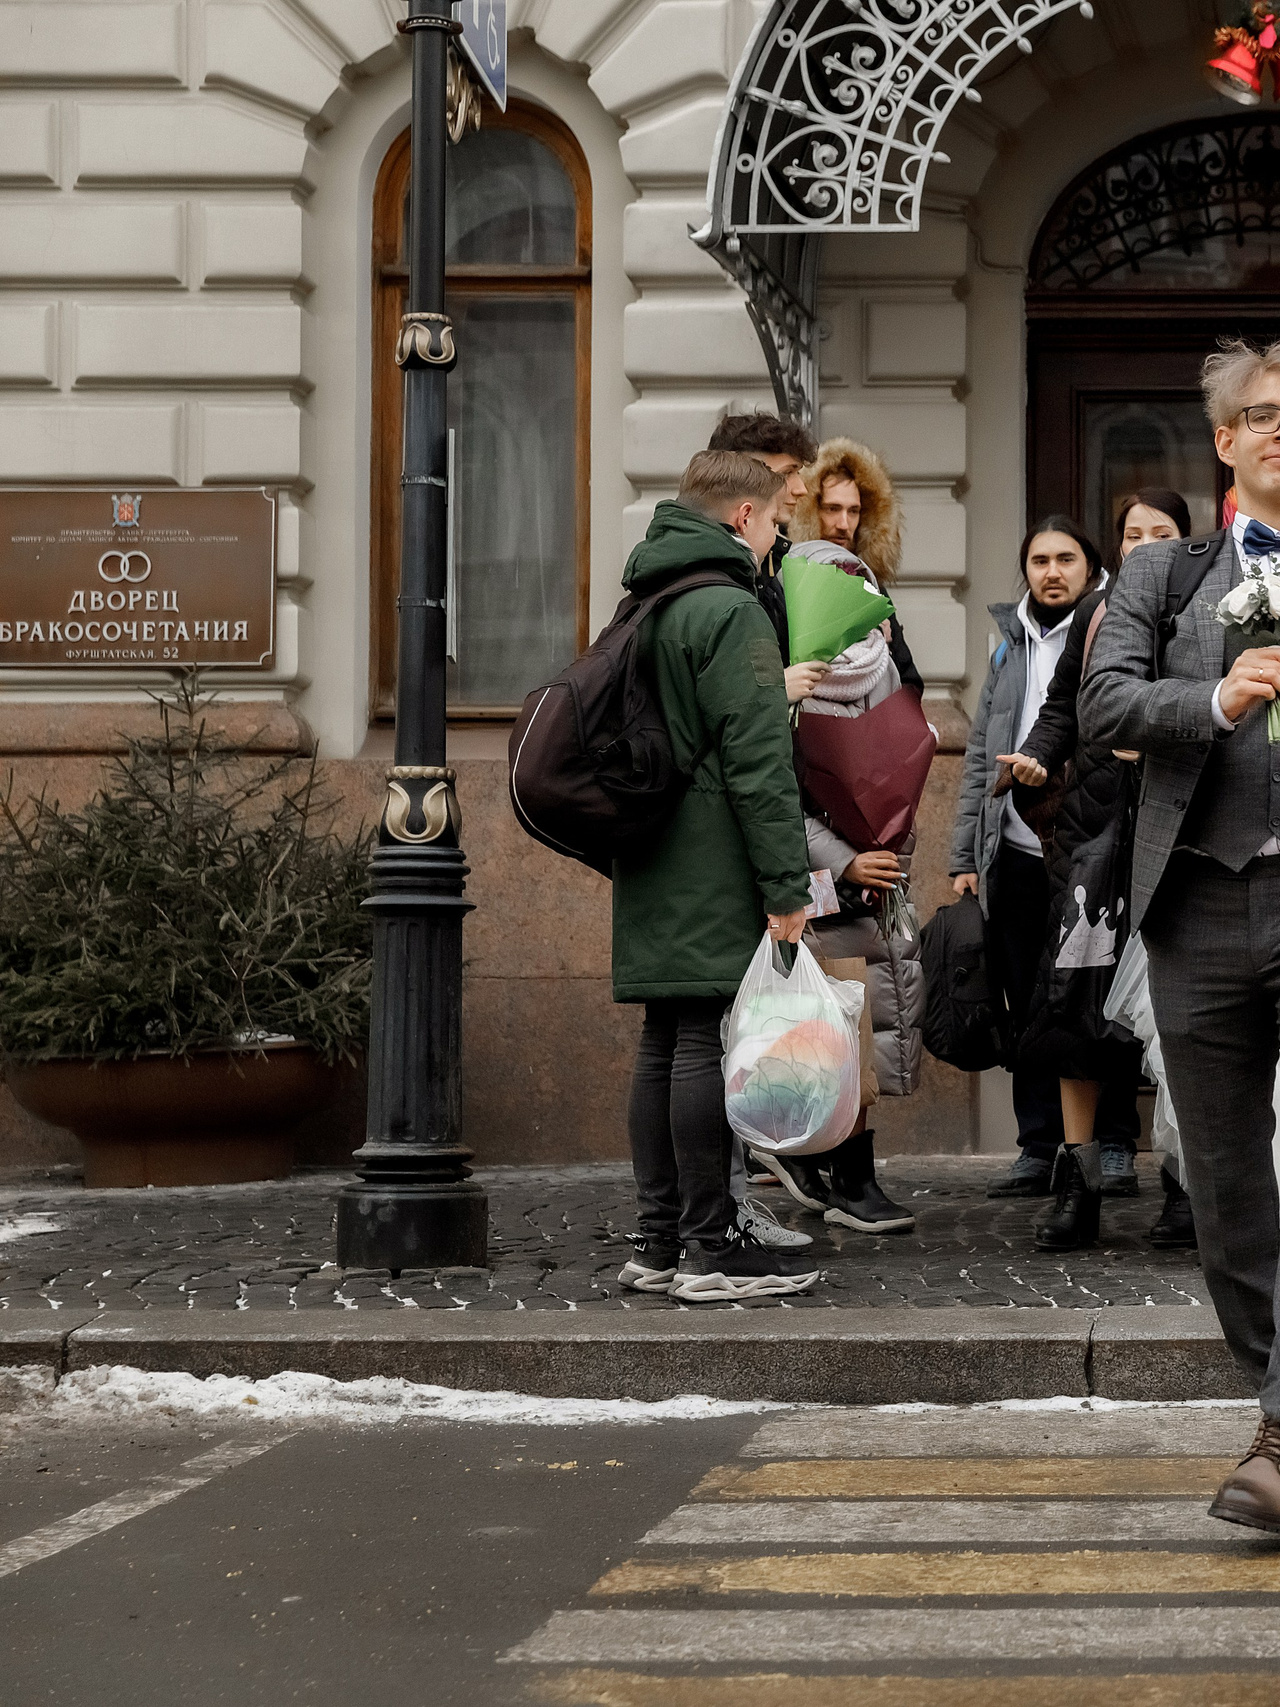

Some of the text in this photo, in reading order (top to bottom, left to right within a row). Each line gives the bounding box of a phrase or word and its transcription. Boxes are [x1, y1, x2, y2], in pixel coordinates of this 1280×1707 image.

[67, 590, 180, 614] ДВОРЕЦ
[0, 621, 249, 642] БРАКОСОЧЕТАНИЯ
[163, 646, 179, 659] 52
